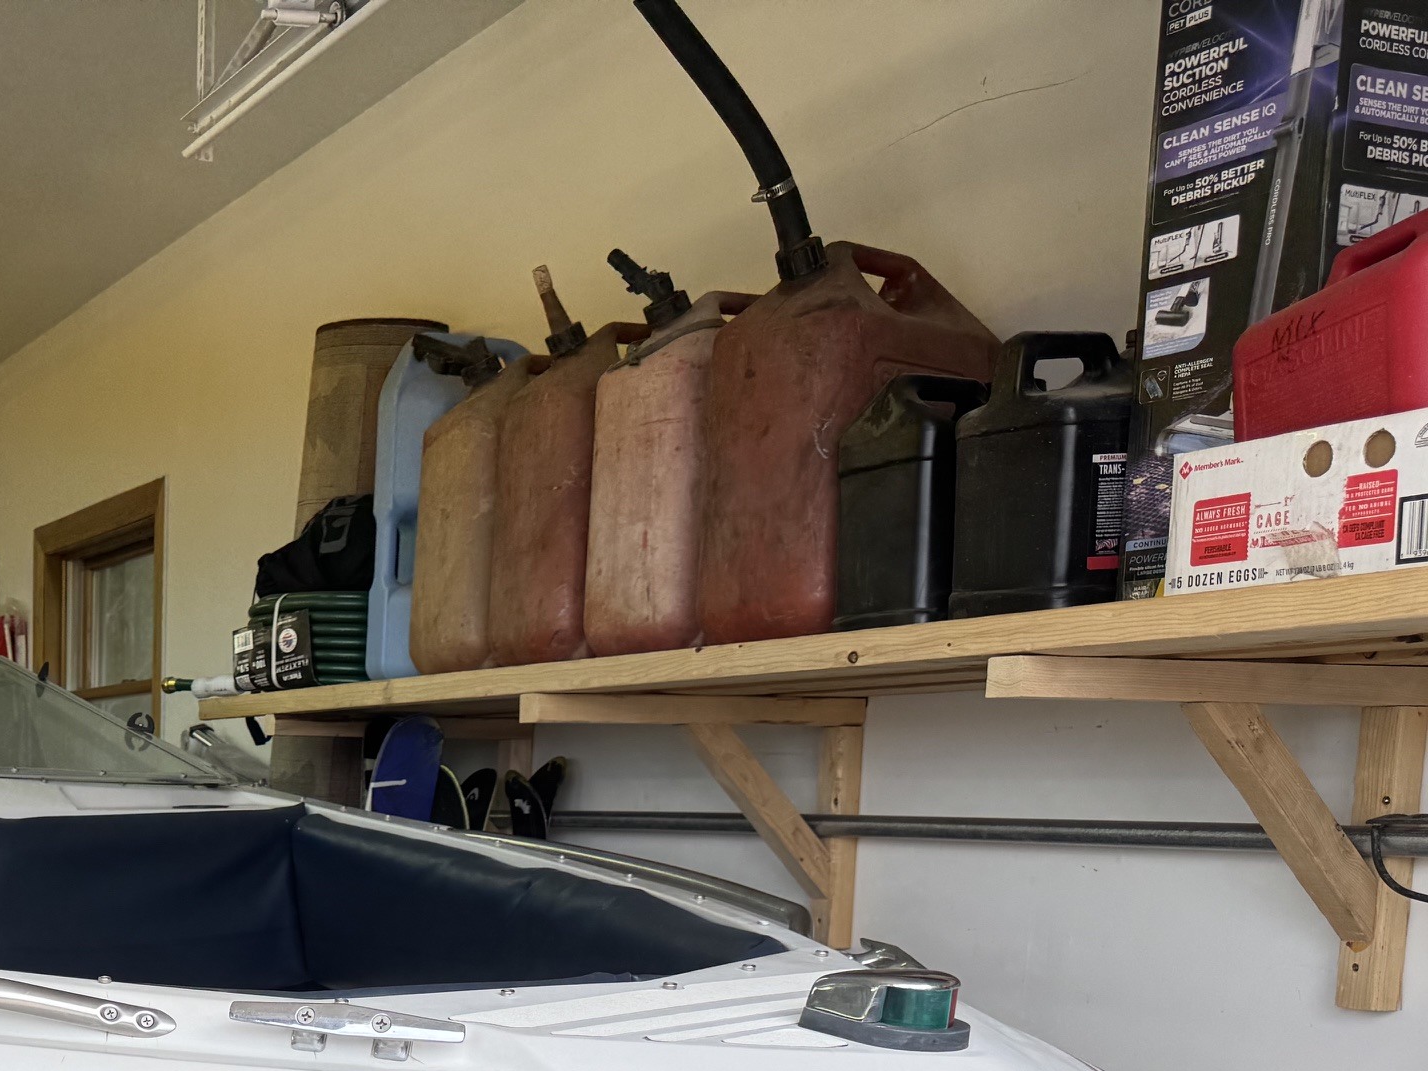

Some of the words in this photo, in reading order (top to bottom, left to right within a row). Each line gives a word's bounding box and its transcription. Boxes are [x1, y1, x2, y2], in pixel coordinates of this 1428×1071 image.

[1169, 19, 1186, 31] PET
[1188, 10, 1210, 25] PLUS
[1360, 19, 1428, 46] POWERFUL
[1164, 37, 1248, 77] POWERFUL
[1359, 36, 1411, 57] CORDLESS
[1163, 57, 1229, 91] SUCTION
[1162, 75, 1222, 104] CORDLESS
[1356, 74, 1408, 99] CLEAN
[1161, 80, 1244, 116] CONVENIENCE
[1359, 97, 1387, 110] SENSES
[1388, 102, 1403, 112] THE
[1402, 104, 1420, 115] DIRT
[1354, 105, 1360, 114] &
[1361, 106, 1419, 123] AUTOMATICALLY
[1163, 125, 1210, 150] CLEAN
[1213, 108, 1260, 134] SENSE
[1261, 102, 1277, 118] IQ
[1164, 156, 1187, 169] CAN'T
[1188, 152, 1203, 162] SEE
[1210, 129, 1272, 155] AUTOMATICALLY
[1178, 143, 1207, 158] SENSES
[1208, 137, 1223, 148] THE
[1223, 132, 1242, 144] DIRT
[1243, 126, 1259, 137] YOU
[1359, 131, 1371, 140] For
[1372, 133, 1383, 143] Up
[1383, 136, 1392, 144] to
[1392, 134, 1418, 151] 50%
[1420, 139, 1428, 152] B
[1187, 154, 1217, 169] BOOSTS
[1218, 144, 1247, 159] POWER
[1366, 145, 1410, 165] DEBRIS
[1163, 188, 1176, 197] For
[1176, 184, 1186, 194] Up
[1187, 182, 1194, 190] to
[1195, 173, 1219, 188] 50%
[1221, 159, 1265, 181] BETTER
[1171, 186, 1211, 206] DEBRIS
[1213, 173, 1256, 194] PICKUP
[1344, 189, 1376, 200] MultiFLEX
[1268, 178, 1281, 226] CORDLESS
[1154, 232, 1183, 245] MultiFLEX
[1265, 226, 1274, 245] PRO
[1099, 463, 1125, 475] TRANS-
[1193, 461, 1224, 472] Member's
[1224, 457, 1241, 465] Mark
[1358, 480, 1380, 490] RAISED
[1195, 509, 1221, 521] ALWAYS
[1222, 504, 1246, 518] FRESH
[1256, 510, 1291, 530] CAGE
[1187, 571, 1223, 588] DOZEN
[1228, 567, 1258, 583] EGGS
